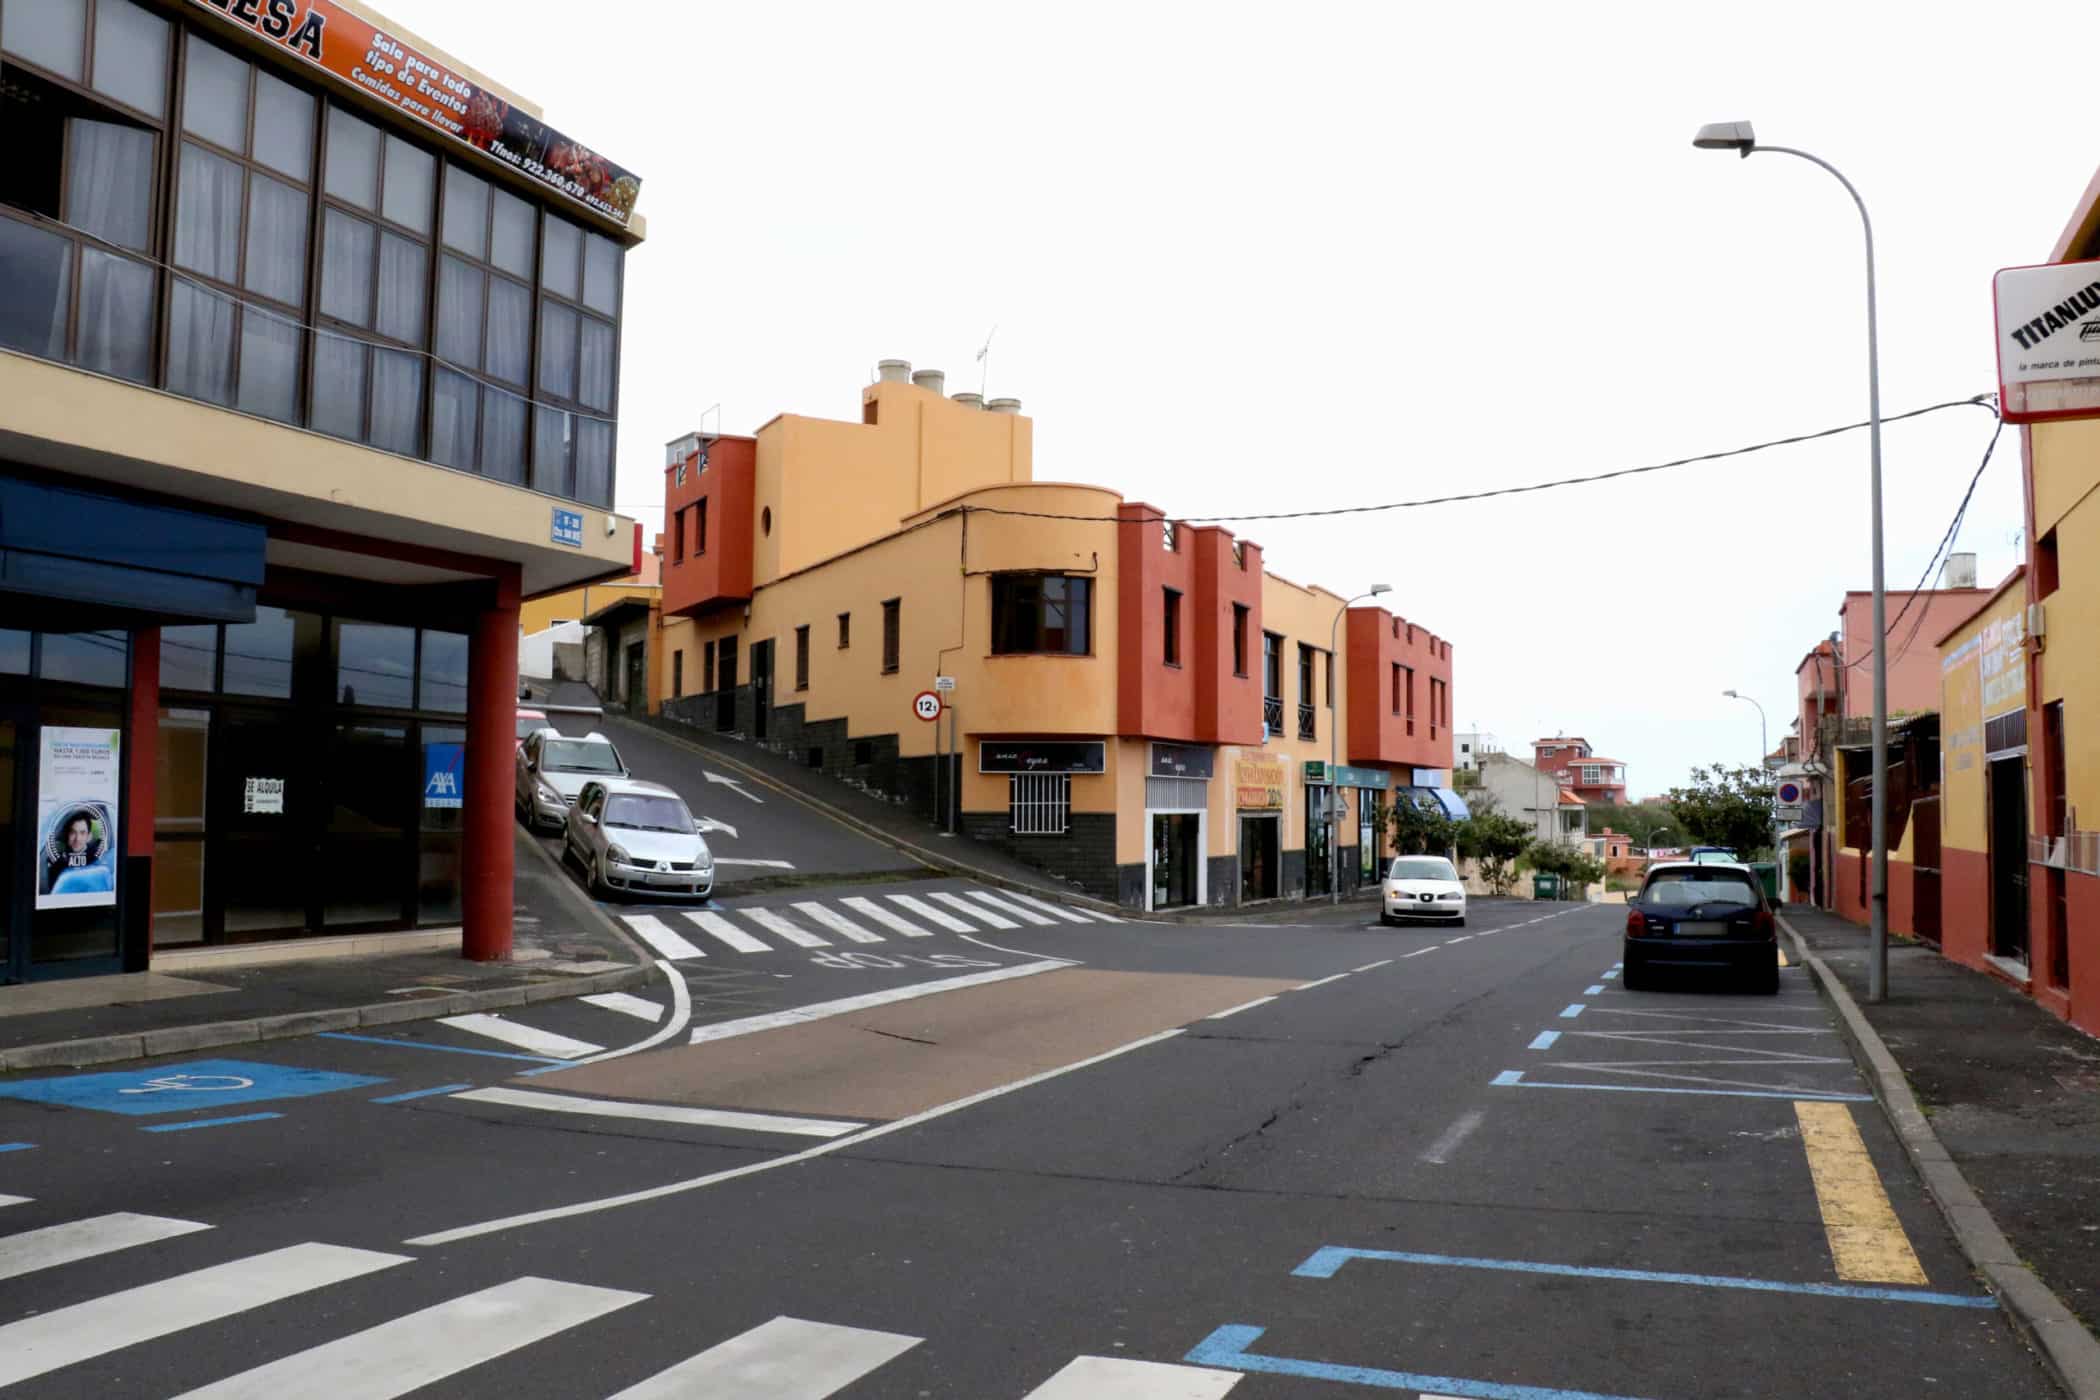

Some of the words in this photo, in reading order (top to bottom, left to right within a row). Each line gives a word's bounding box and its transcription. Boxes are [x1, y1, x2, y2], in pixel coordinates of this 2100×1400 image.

[365, 50, 394, 74] tipo
[397, 66, 415, 86] de
[417, 78, 468, 114] Eventos
[372, 32, 403, 59] Sala
[405, 56, 439, 80] para
[442, 74, 471, 98] todo
[351, 67, 400, 100] Comidas
[401, 97, 430, 116] para
[432, 109, 464, 133] llevar
[2031, 361, 2059, 369] marca
[2063, 360, 2075, 368] de
[425, 771, 457, 795] AXA
[68, 855, 87, 867] ALTO
